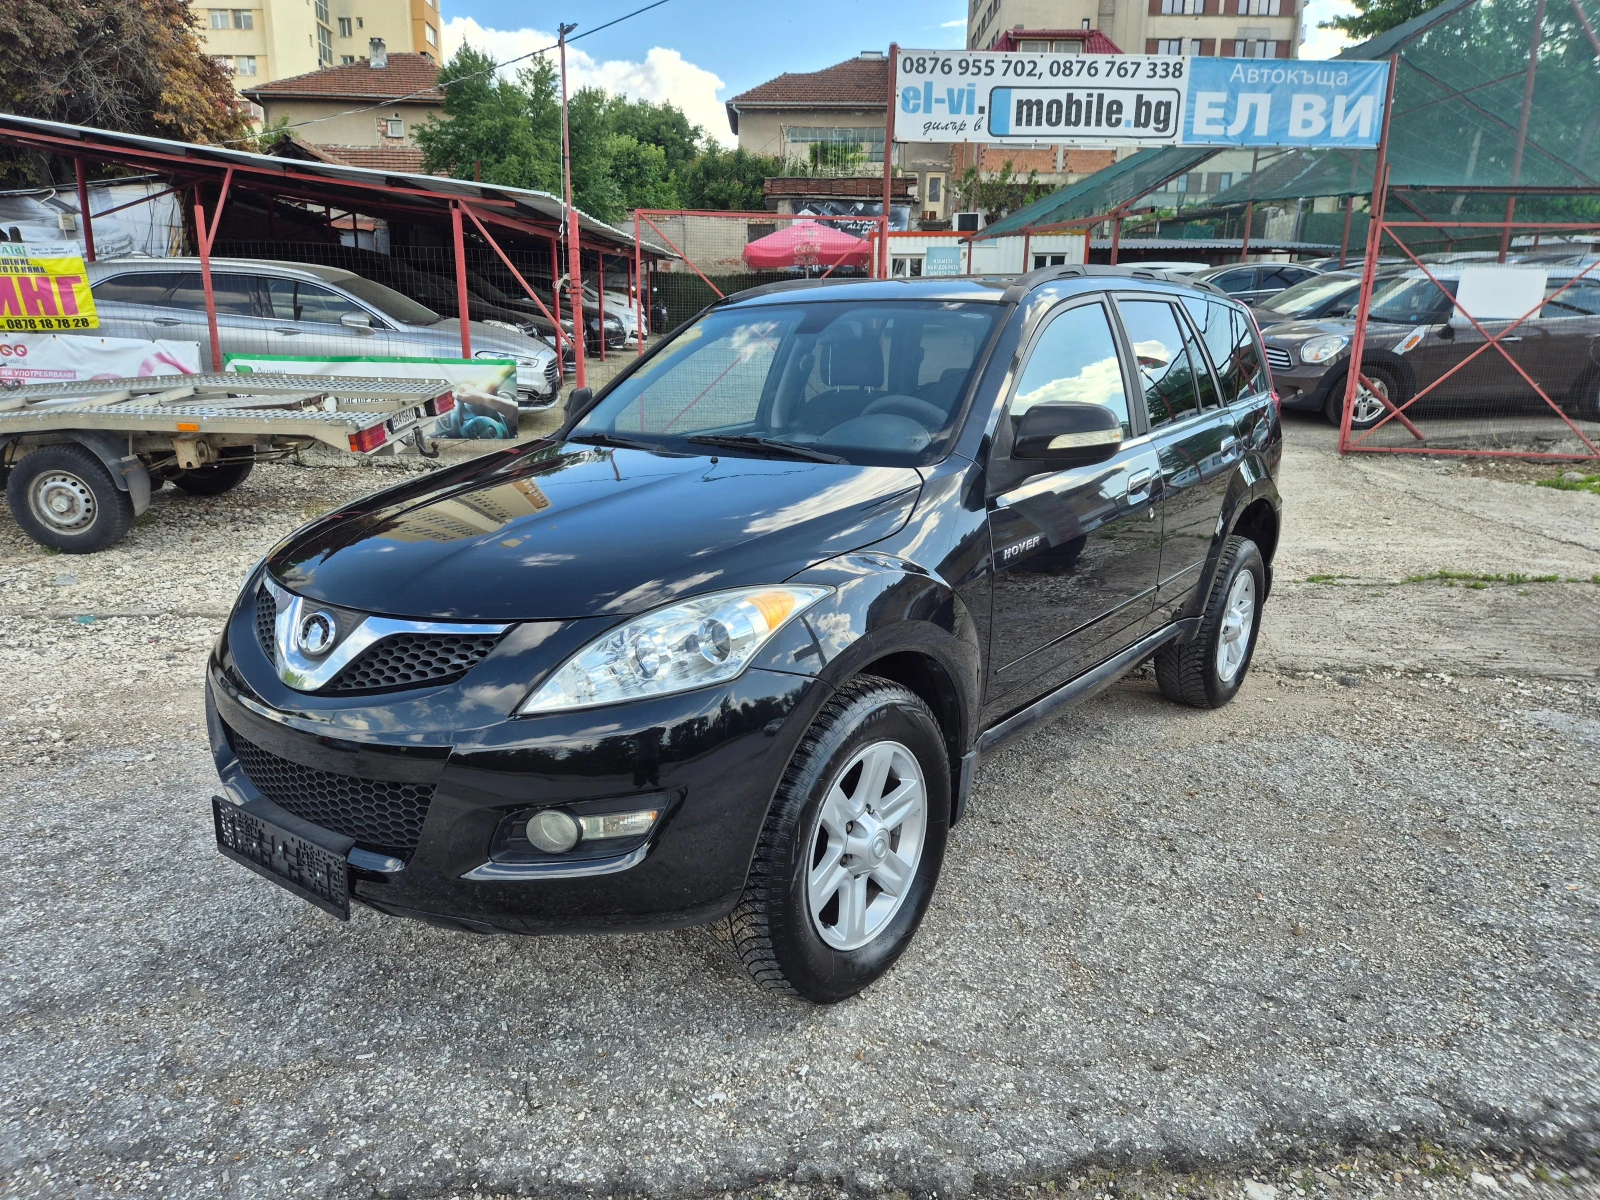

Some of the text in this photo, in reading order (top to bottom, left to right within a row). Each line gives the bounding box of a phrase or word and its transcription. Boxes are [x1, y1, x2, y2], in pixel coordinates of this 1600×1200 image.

[902, 56, 1183, 79] 0876 955 702, 0876 767 338
[1229, 63, 1348, 90] Автокъща
[1015, 92, 1172, 133] mobile.bg
[1192, 91, 1374, 138] ЕЛ ВИ
[922, 119, 967, 135] дилър
[6, 317, 90, 329] 0878 18 78 28
[1003, 535, 1040, 560] HOVER
